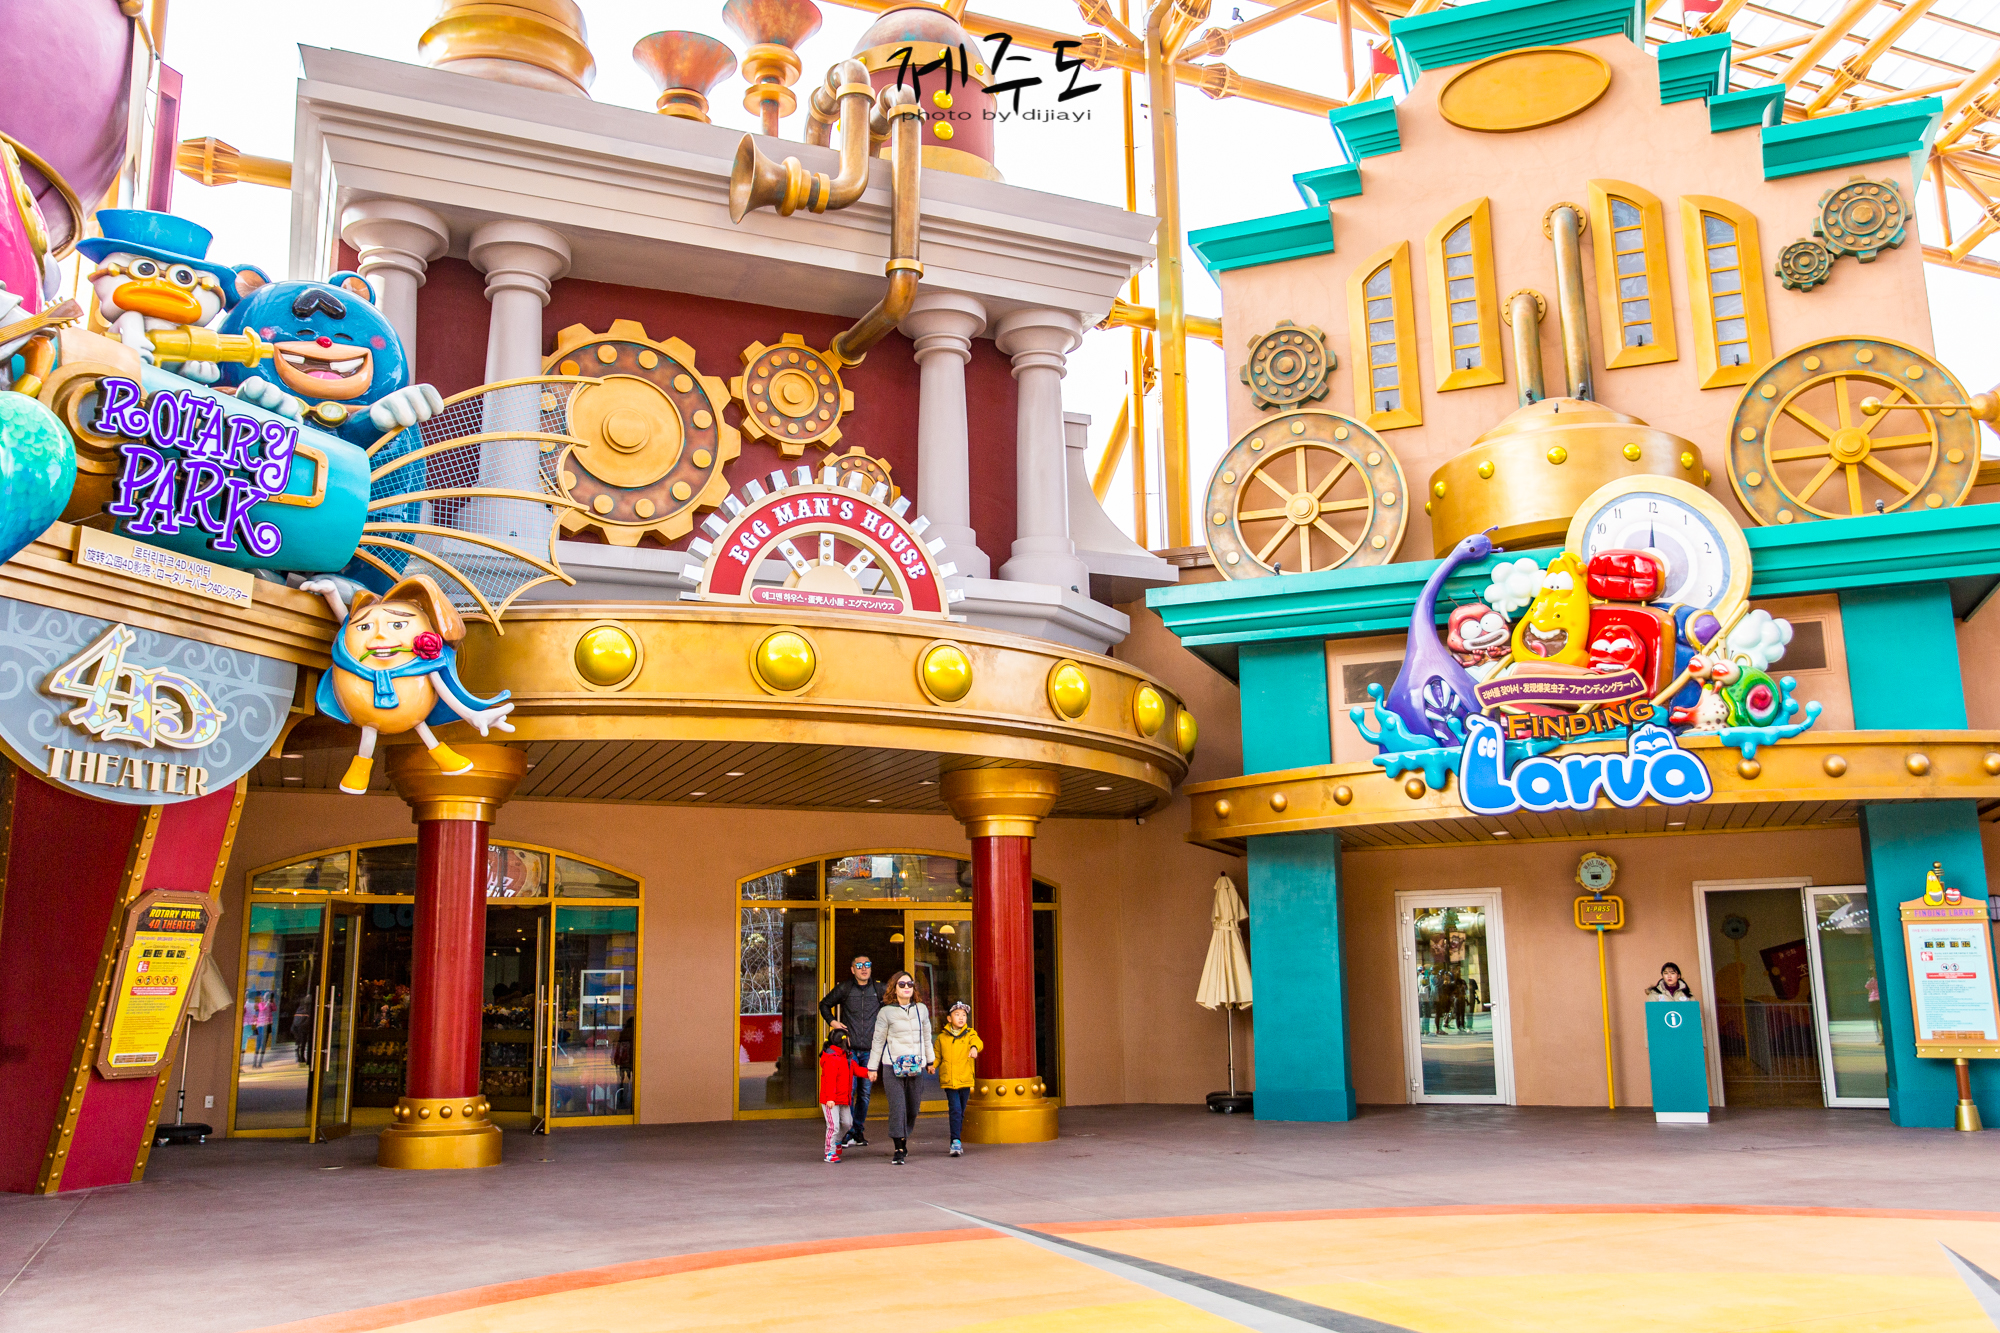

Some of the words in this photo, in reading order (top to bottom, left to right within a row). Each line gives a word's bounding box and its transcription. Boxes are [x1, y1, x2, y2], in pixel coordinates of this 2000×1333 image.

[93, 376, 299, 495] ROTARY
[106, 443, 282, 558] PARK
[1614, 508, 1622, 519] 11
[1648, 501, 1659, 514] 12
[1597, 523, 1607, 534] 10
[728, 519, 771, 566] EGG
[772, 497, 855, 528] MAN'S
[860, 508, 927, 580] HOUSE
[1704, 542, 1712, 554] 2
[132, 546, 175, 567] 로터리파크
[175, 560, 187, 571] 4D
[188, 562, 211, 579] 시어터
[761, 591, 782, 602] 에그맨
[783, 593, 804, 603] 하우스
[1707, 585, 1713, 598] 3
[46, 623, 228, 750] 4D
[1482, 689, 1501, 700] 라바를
[1500, 684, 1519, 696] 찾아서
[1505, 699, 1655, 741] FINDING
[44, 744, 209, 797] THEATER
[1459, 713, 1713, 815] Larva
[148, 908, 180, 919] ROTARY
[180, 910, 201, 919] PARK
[1585, 905, 1611, 913] X-PASS
[1914, 909, 1946, 917] FINDING
[1949, 908, 1975, 917] LARVA
[148, 919, 161, 929] 4D
[162, 919, 196, 930] THEATER
